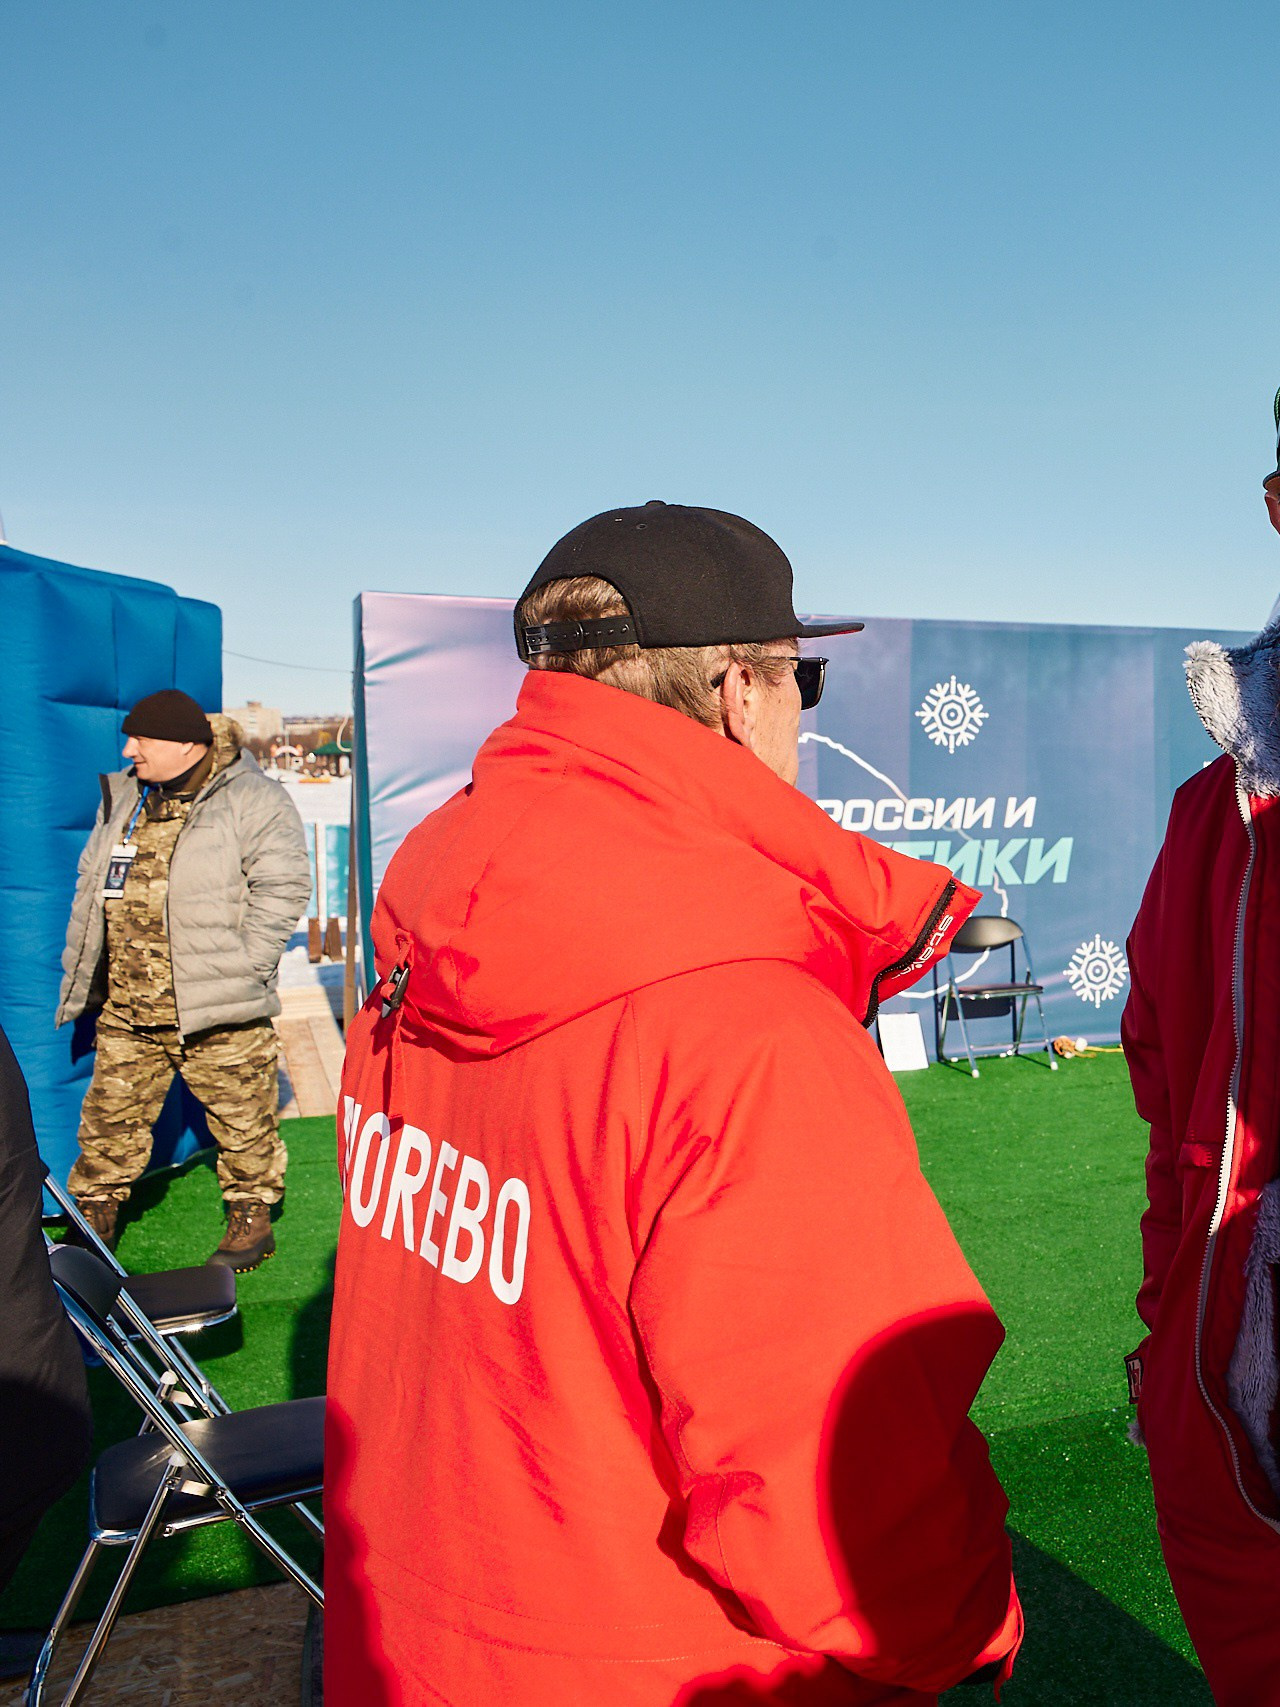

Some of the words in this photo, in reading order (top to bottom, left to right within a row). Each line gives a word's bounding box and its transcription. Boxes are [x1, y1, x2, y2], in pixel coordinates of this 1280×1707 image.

[815, 797, 996, 831] РОССИИ
[1003, 796, 1037, 828] И
[879, 837, 1074, 887] ТИКИ
